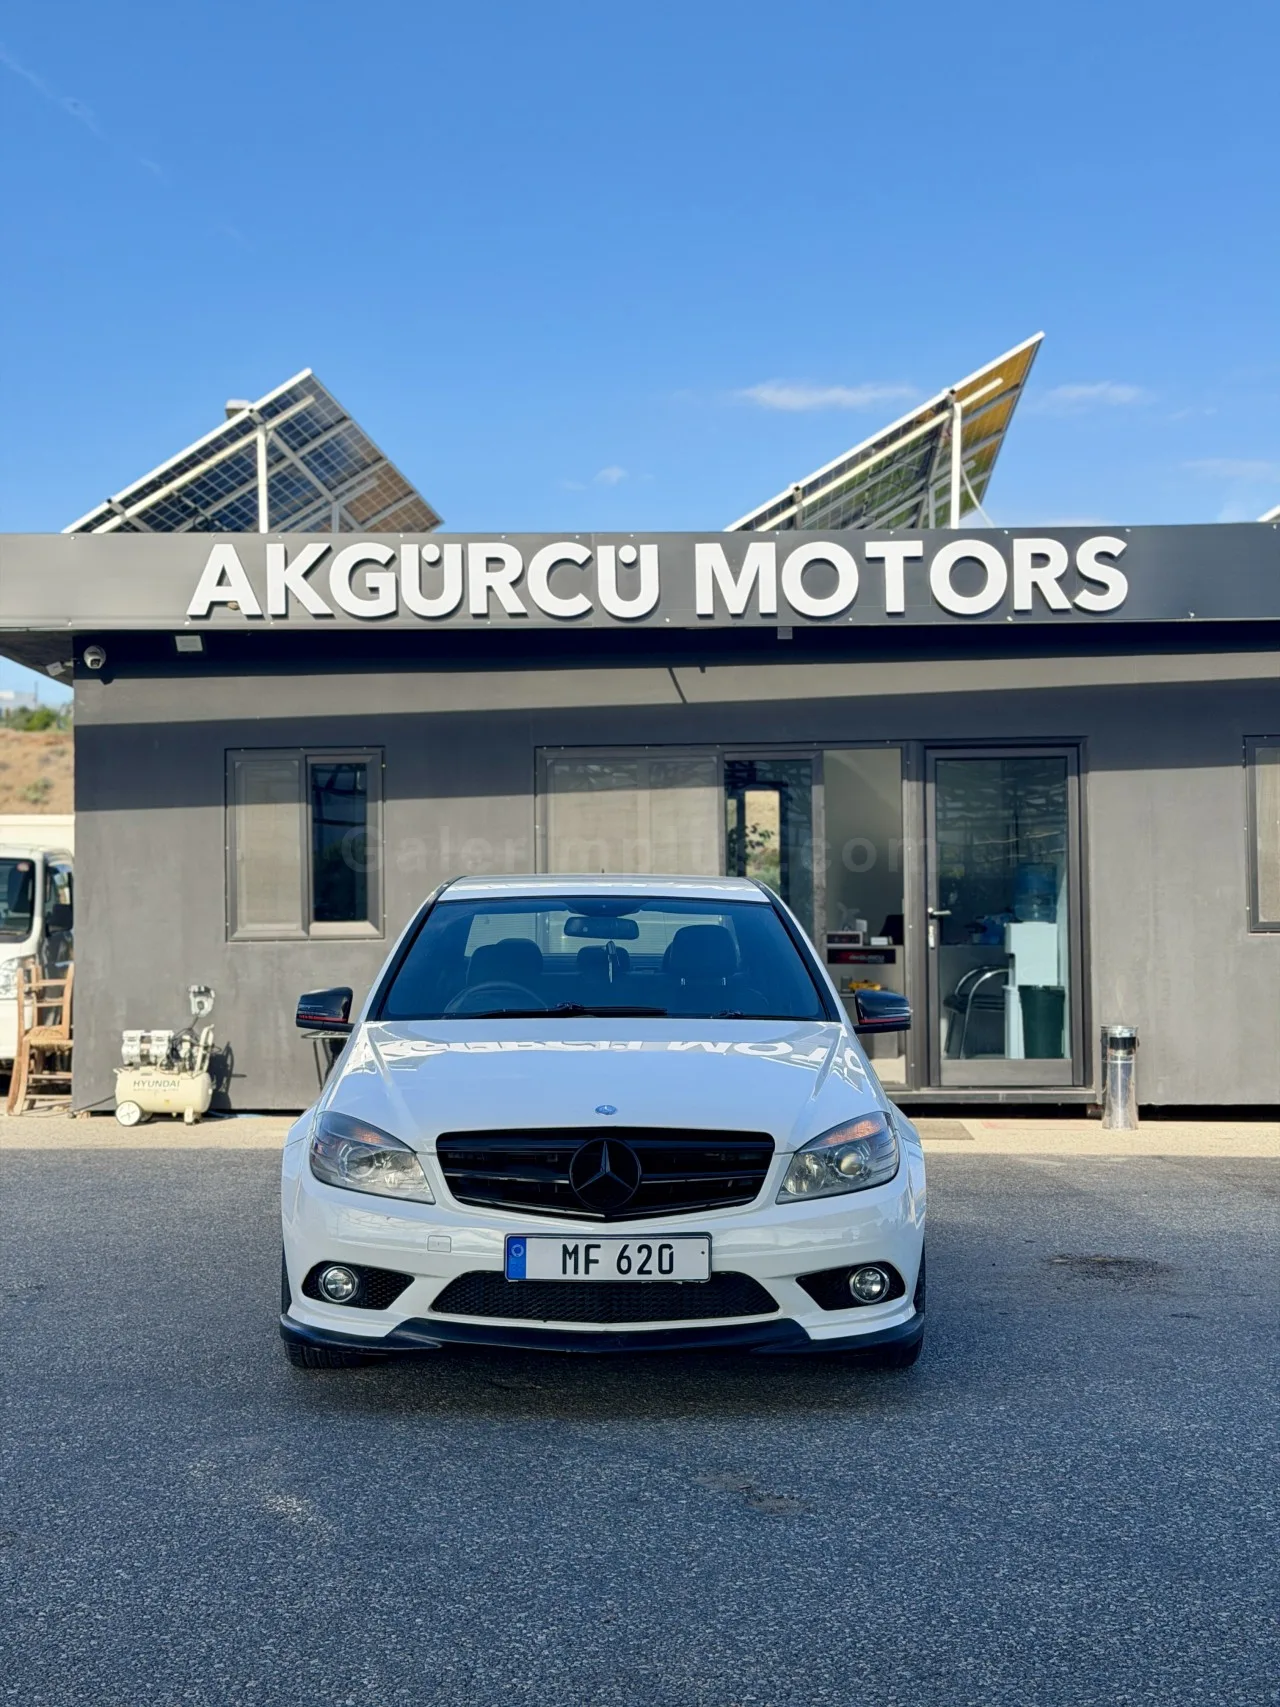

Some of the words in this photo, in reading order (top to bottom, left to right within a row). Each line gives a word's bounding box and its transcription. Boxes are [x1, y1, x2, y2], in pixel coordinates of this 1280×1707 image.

[694, 536, 1129, 618] MOTORS
[132, 1080, 180, 1088] HYUNDAI
[561, 1243, 602, 1275] MF
[616, 1243, 674, 1276] 620
